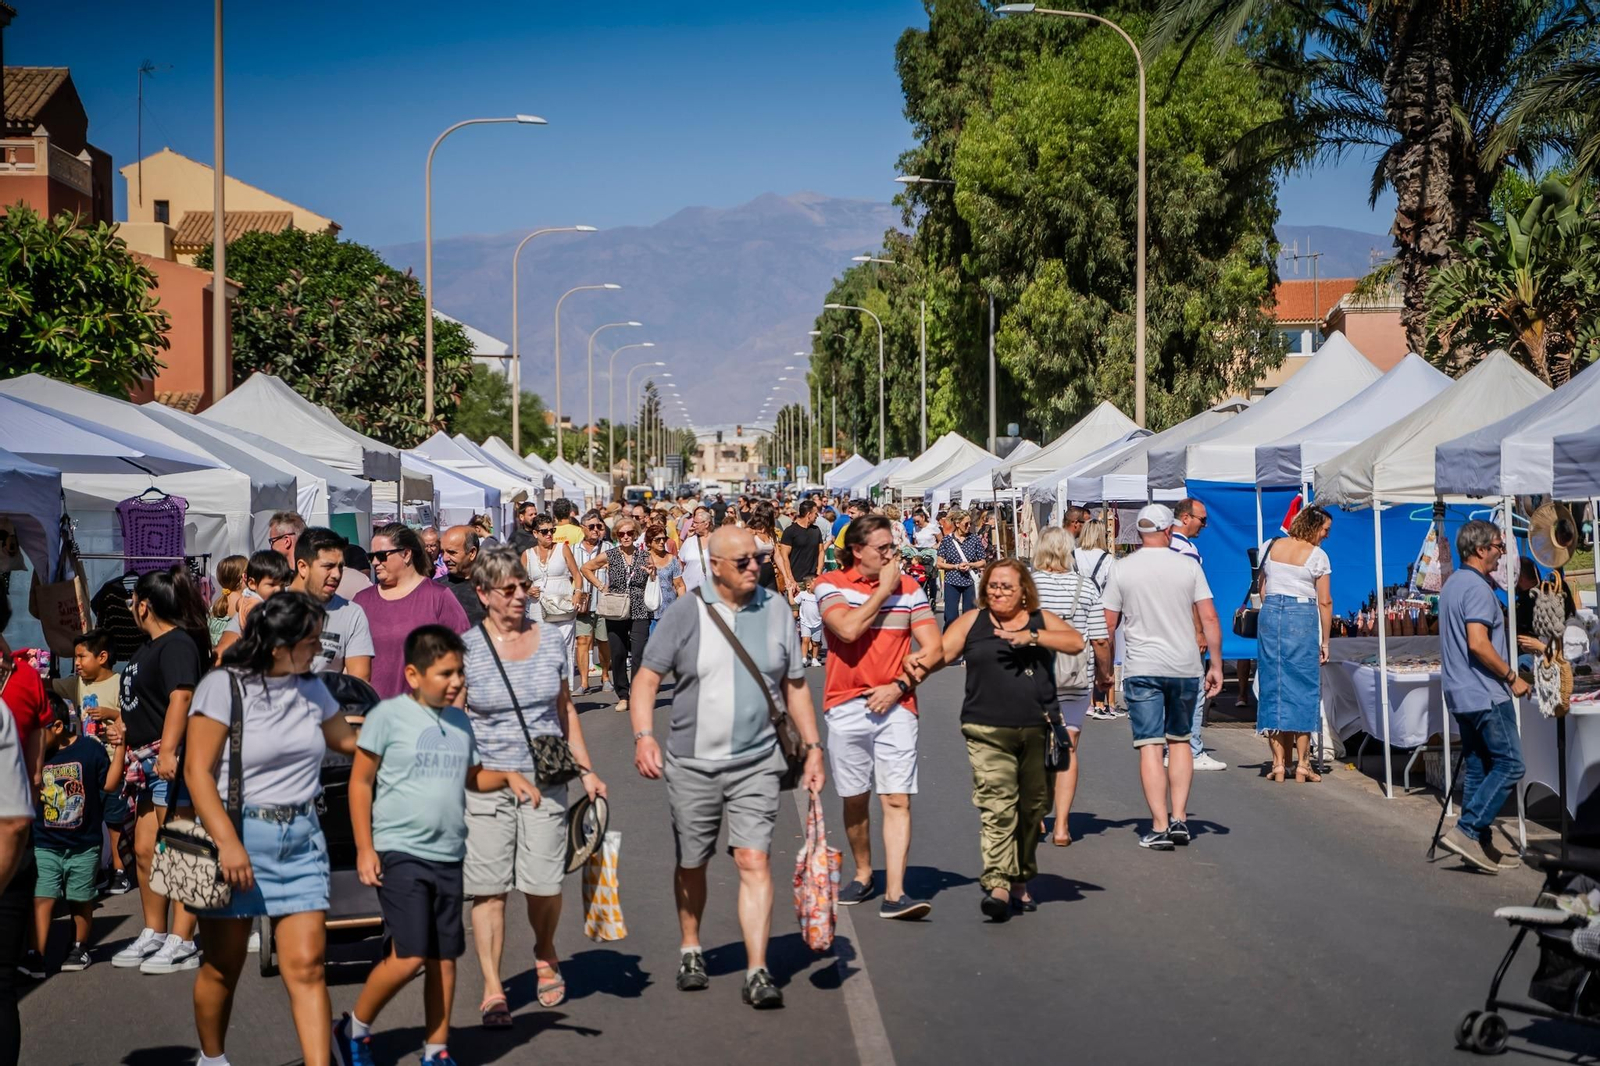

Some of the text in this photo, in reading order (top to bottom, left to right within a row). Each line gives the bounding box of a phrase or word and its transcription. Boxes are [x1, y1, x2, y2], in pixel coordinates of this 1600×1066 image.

[231, 721, 241, 752] TOUS
[414, 752, 464, 769] SEA DAY
[229, 778, 239, 810] TOUS
